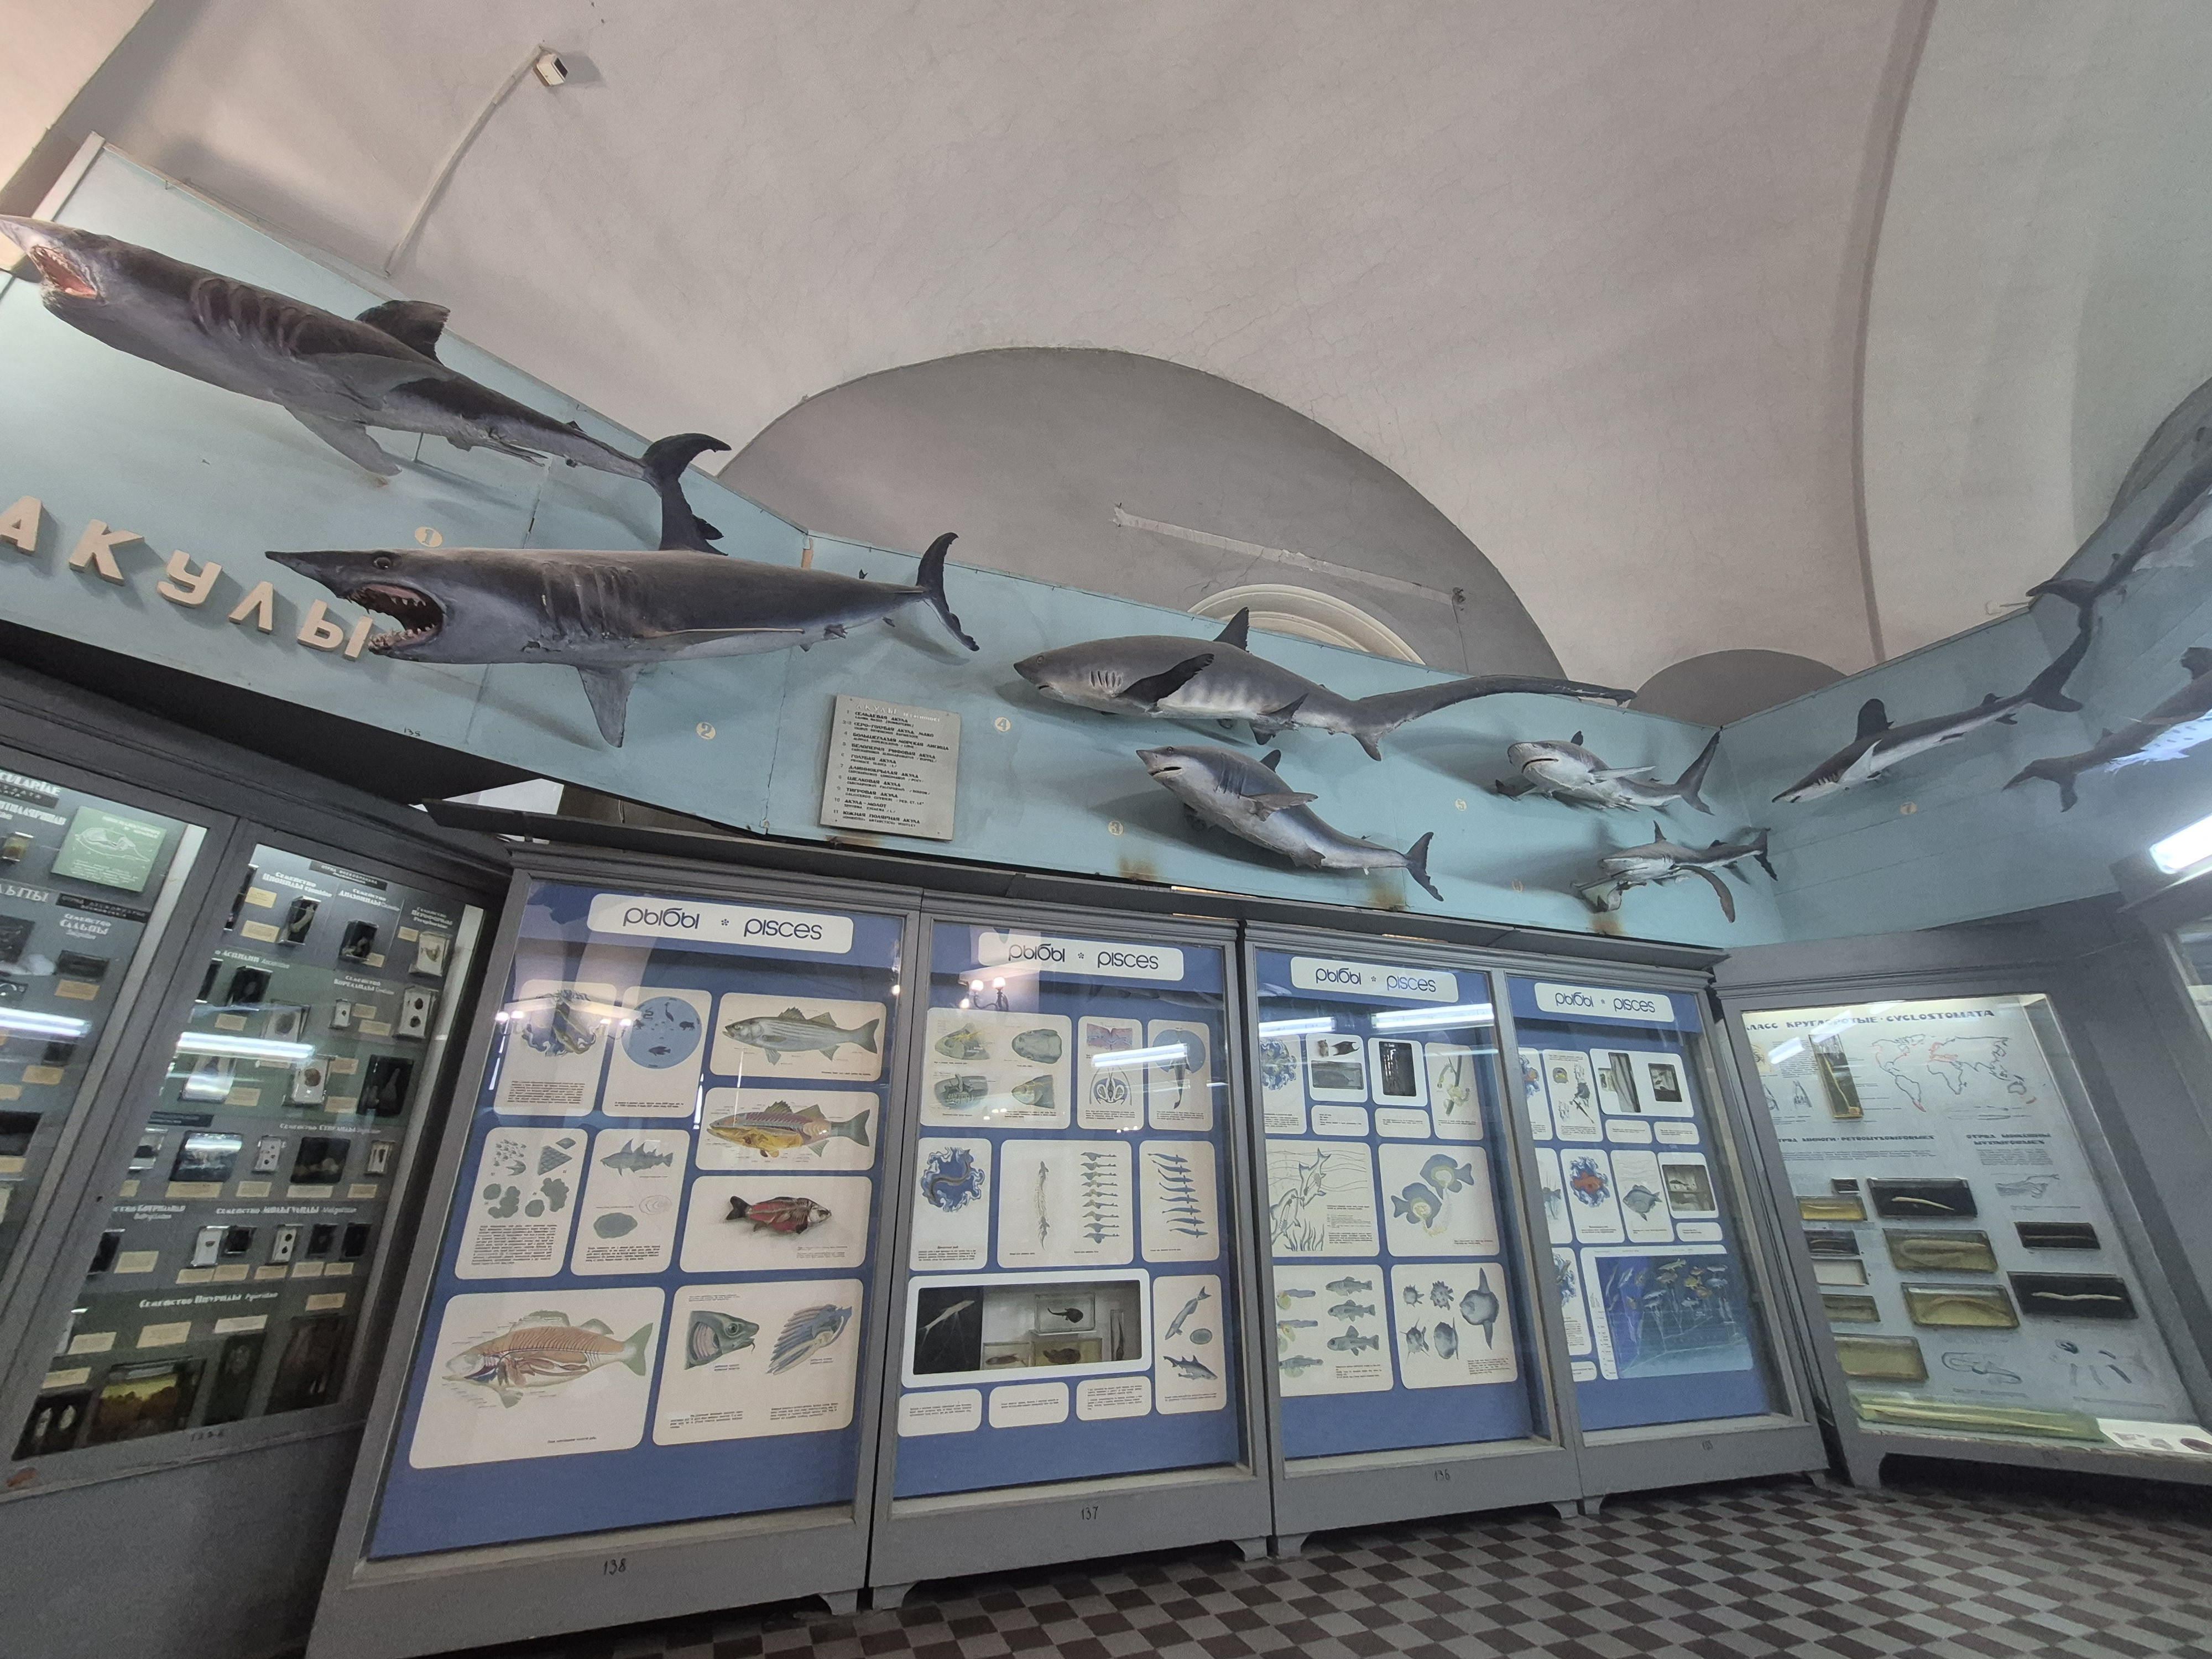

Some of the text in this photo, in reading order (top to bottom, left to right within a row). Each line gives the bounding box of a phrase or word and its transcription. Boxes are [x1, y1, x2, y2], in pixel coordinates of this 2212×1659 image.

[422, 529, 435, 545] 1
[0, 496, 373, 662] АКУЛЫ
[856, 703, 896, 714] АКУЛЫ
[701, 722, 712, 738] 2
[853, 722, 894, 731] СЕРО-ГОЛУБАЯ
[997, 718, 1007, 731] 4
[852, 733, 896, 742] БОЛЬШЕГЛАЗАЯ
[848, 765, 898, 775] ДЛИННОКРЫЛАЯ
[847, 776, 879, 784] ШЕЛКОВАЯ
[623, 906, 823, 940] рыбы pisces
[1008, 943, 1159, 970] рыбы pisces
[1316, 968, 1436, 993] рыбы pisces
[1555, 992, 1656, 1013] рыбы pisces
[1886, 1010, 1995, 1022] CYCLOSTOMATA
[1082, 1506, 1099, 1520] 137
[604, 1558, 626, 1575] 138
